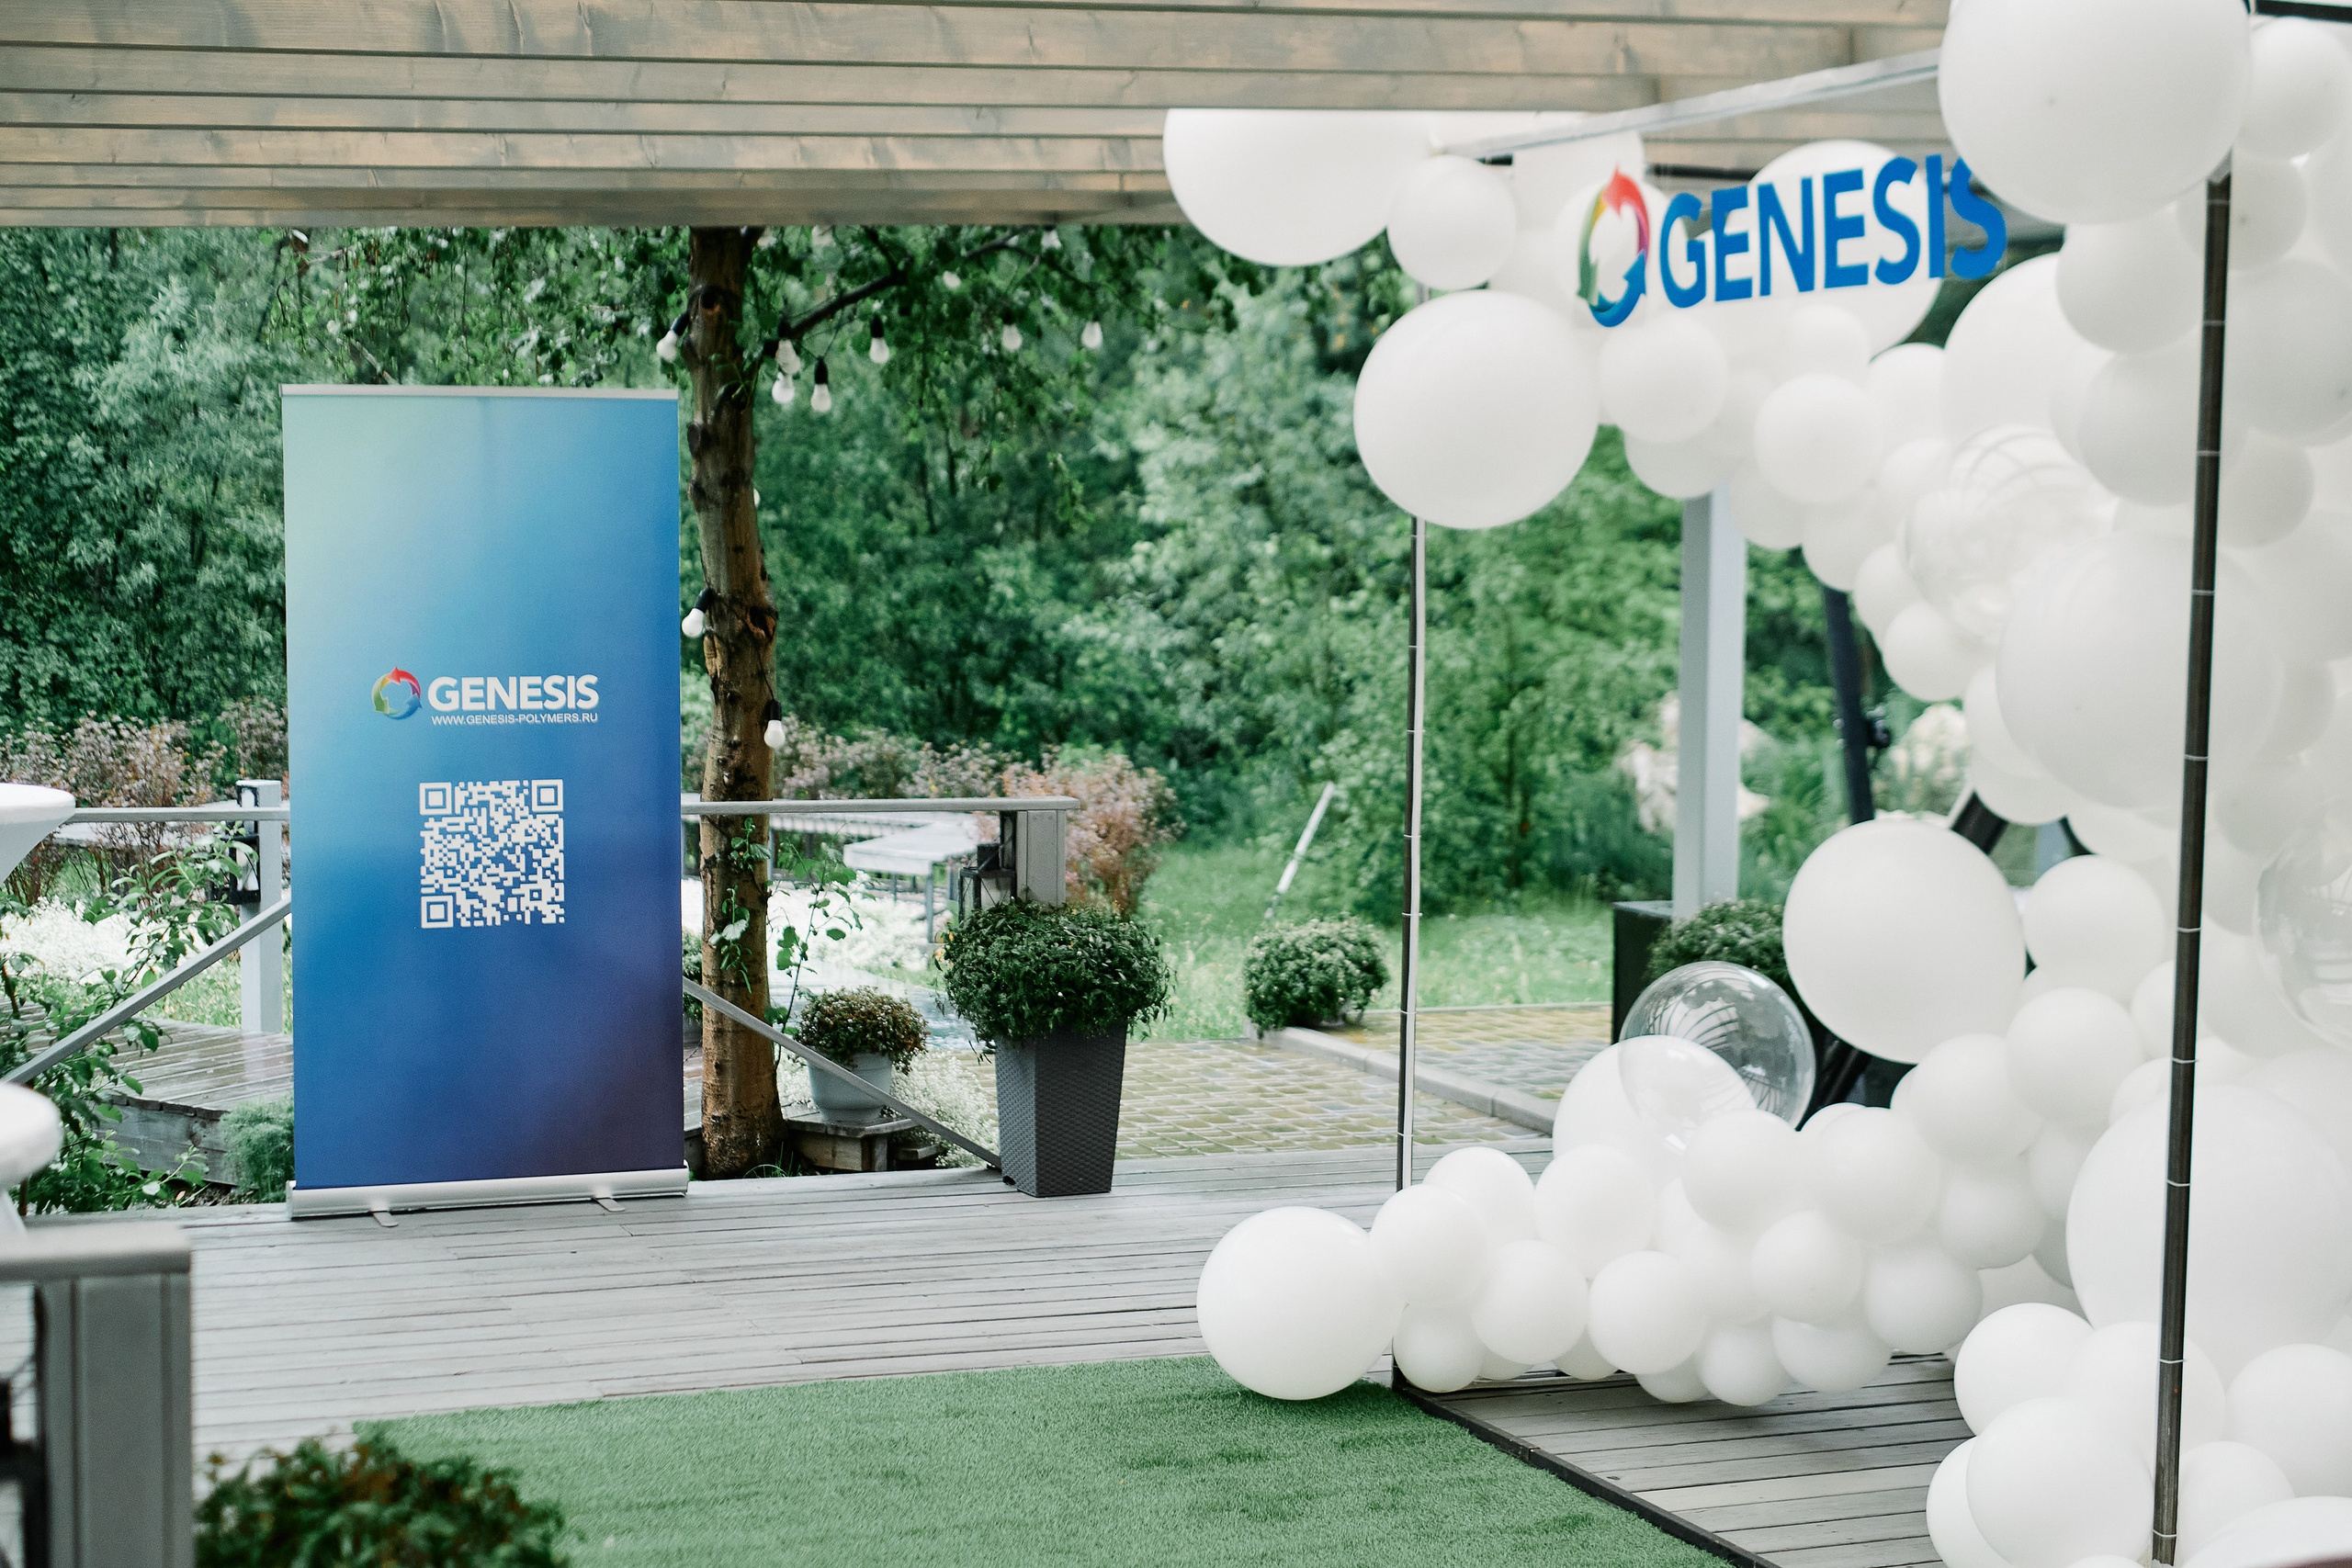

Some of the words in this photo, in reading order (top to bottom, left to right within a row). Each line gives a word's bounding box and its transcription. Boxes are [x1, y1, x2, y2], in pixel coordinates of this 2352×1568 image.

[1659, 153, 2007, 308] GENESIS
[427, 674, 599, 711] GENESIS
[431, 712, 598, 726] WWW.GENESIS-POLYMERS.RU
